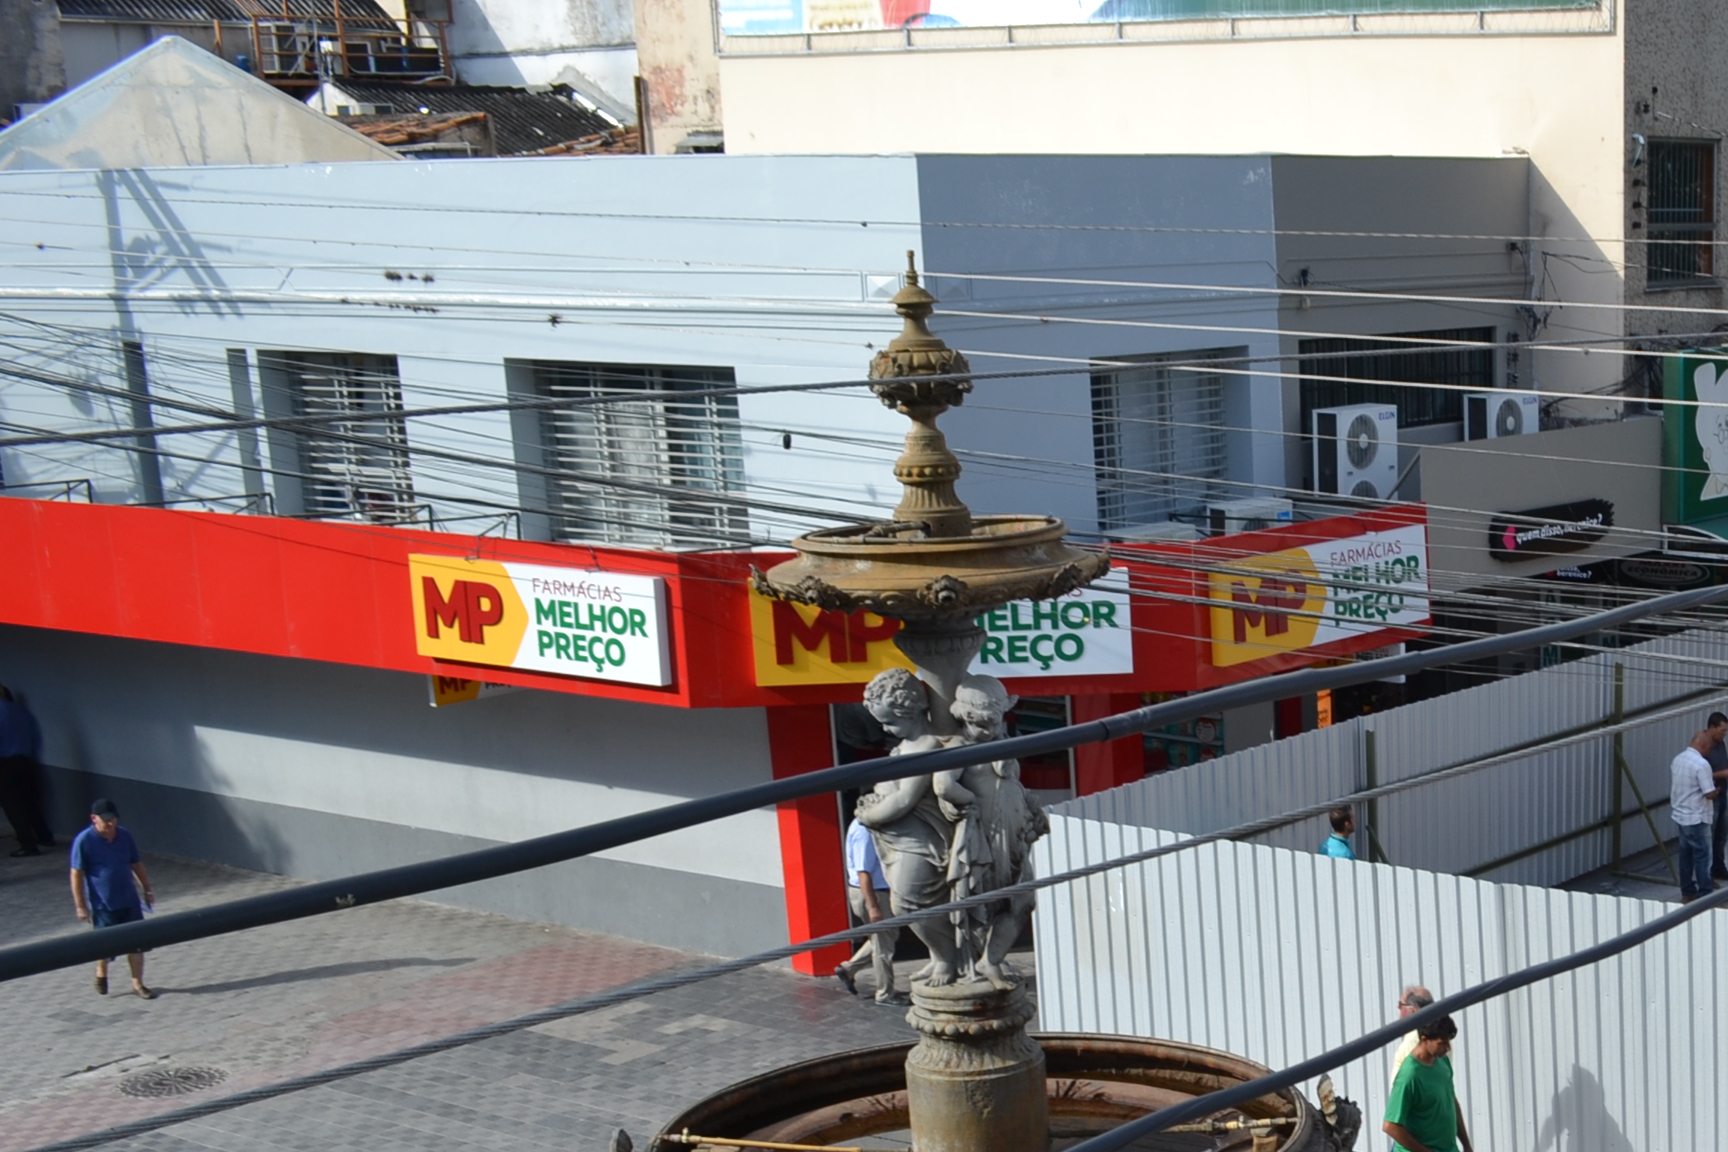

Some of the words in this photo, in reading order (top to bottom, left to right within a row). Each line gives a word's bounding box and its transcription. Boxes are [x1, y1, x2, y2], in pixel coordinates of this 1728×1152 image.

[1378, 411, 1396, 421] ELGIN
[1330, 540, 1403, 567] FARMÁCIAS
[532, 577, 623, 603] FARMÁCIAS
[1231, 569, 1308, 645] MP
[421, 575, 505, 646] MP
[534, 597, 650, 638] MELHOR
[975, 600, 1120, 634] ELHOR
[1333, 592, 1405, 628] PREÇO
[536, 629, 626, 673] PREÇO
[771, 600, 904, 667] MP
[979, 632, 1085, 671] REÇO
